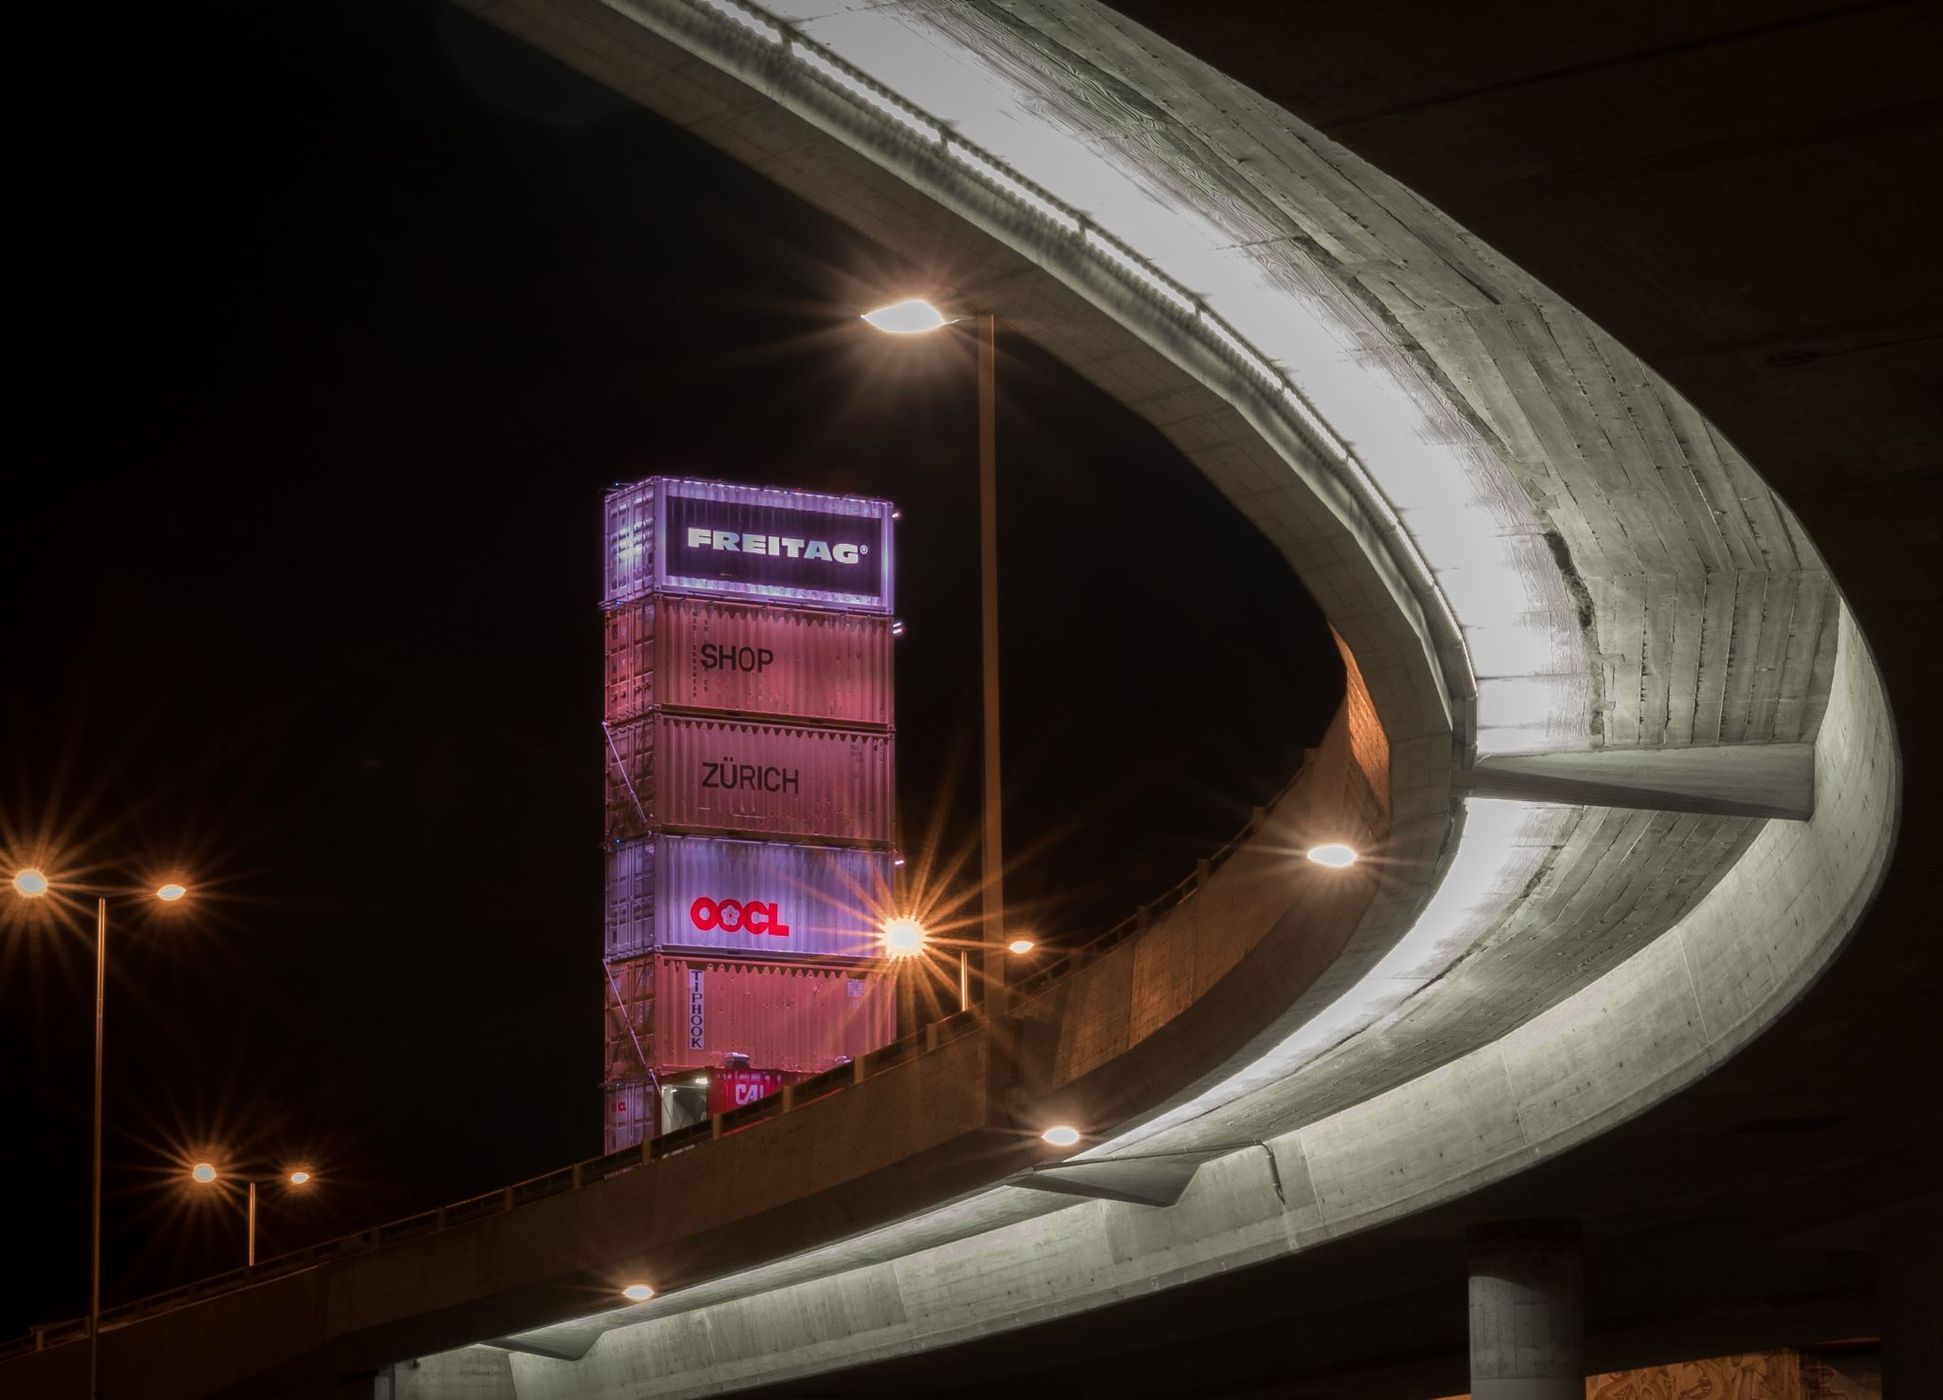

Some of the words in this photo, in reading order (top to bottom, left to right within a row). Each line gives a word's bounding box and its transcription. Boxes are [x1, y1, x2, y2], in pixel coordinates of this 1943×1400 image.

[700, 643, 774, 673] SHOP
[702, 757, 799, 794] ZÜRICH
[690, 897, 789, 936] OOCL
[690, 970, 703, 1048] TIPHOOK
